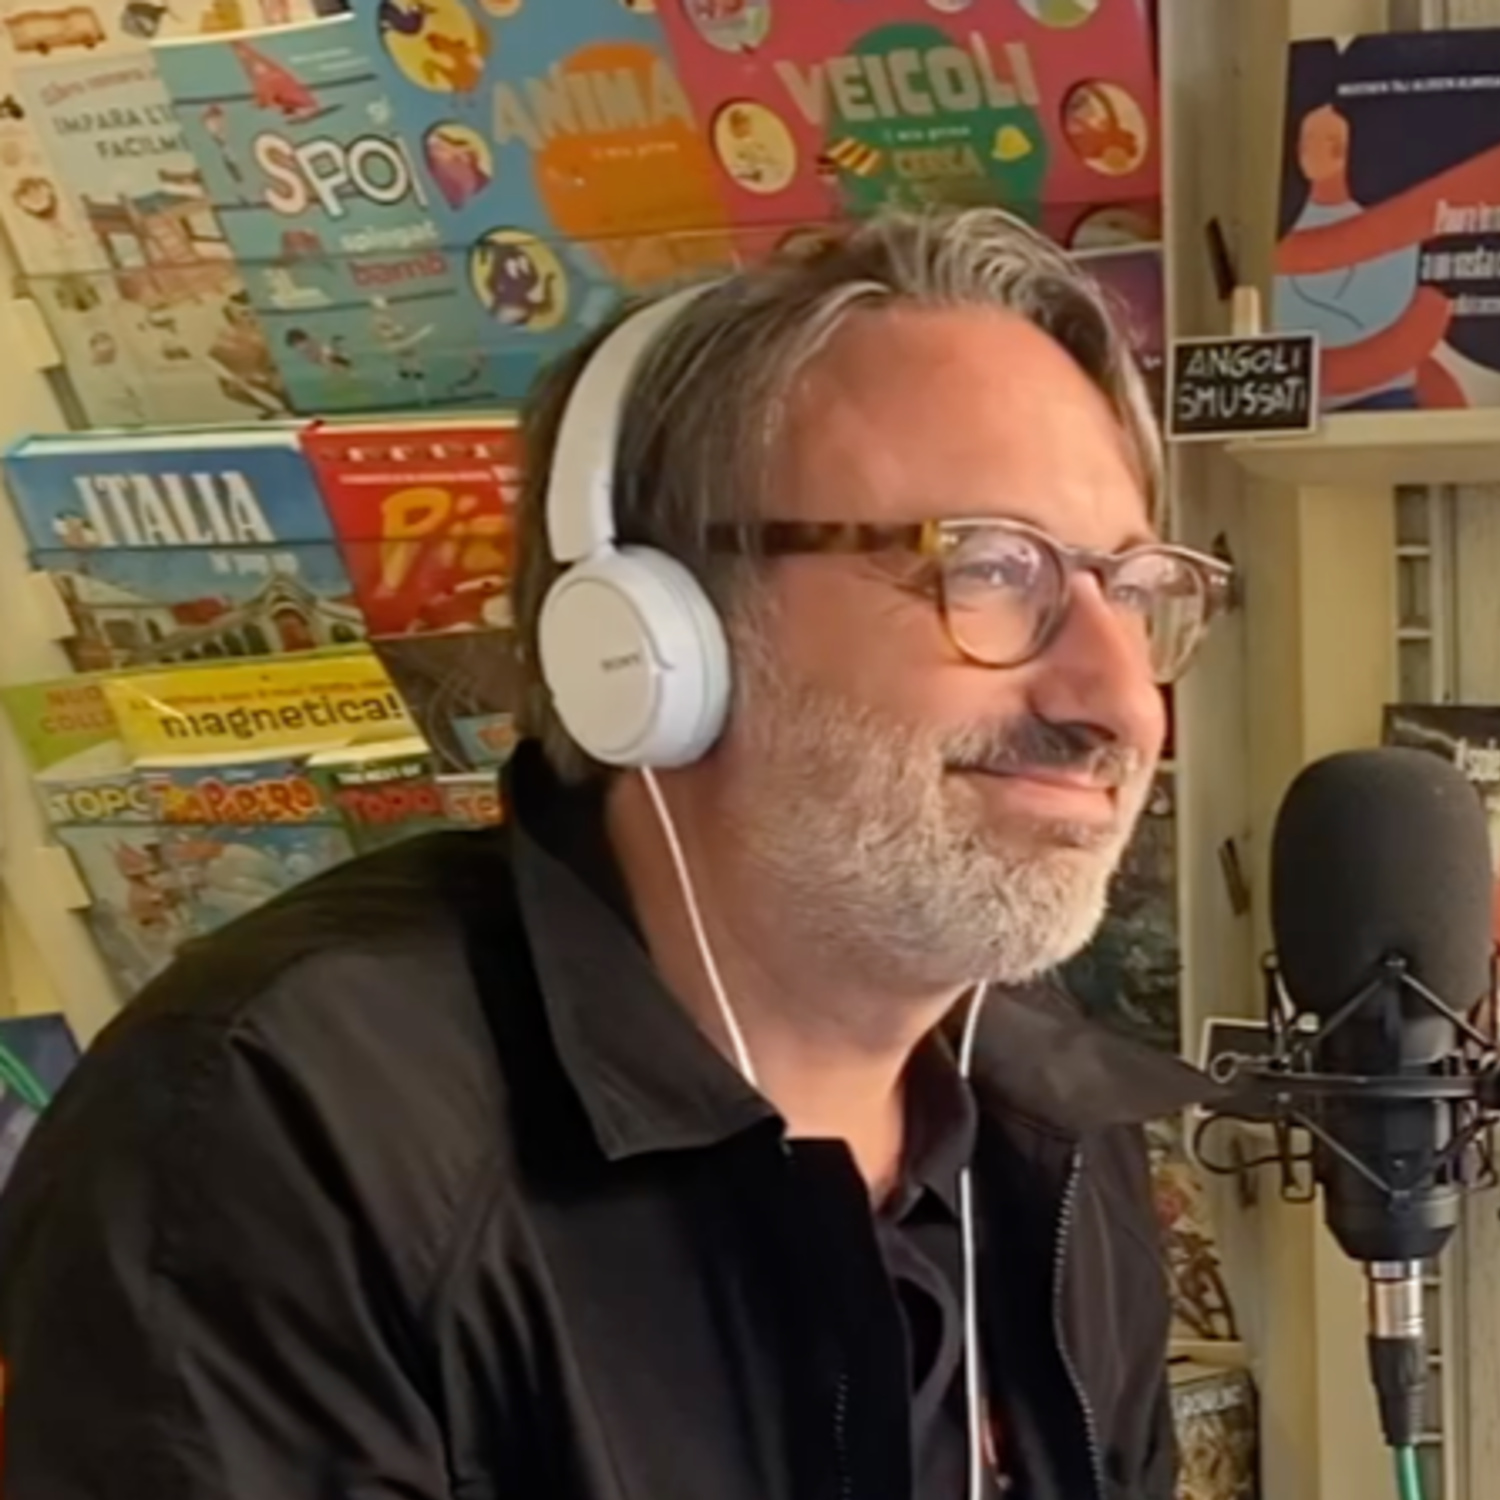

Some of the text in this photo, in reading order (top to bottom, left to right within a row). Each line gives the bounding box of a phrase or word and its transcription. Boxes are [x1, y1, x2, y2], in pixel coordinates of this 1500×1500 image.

[773, 30, 1040, 126] VEICOLI
[254, 133, 429, 217] SPO
[1185, 344, 1303, 379] ANGOLI
[72, 469, 279, 547] ITALIA
[160, 692, 403, 740] magnetica!
